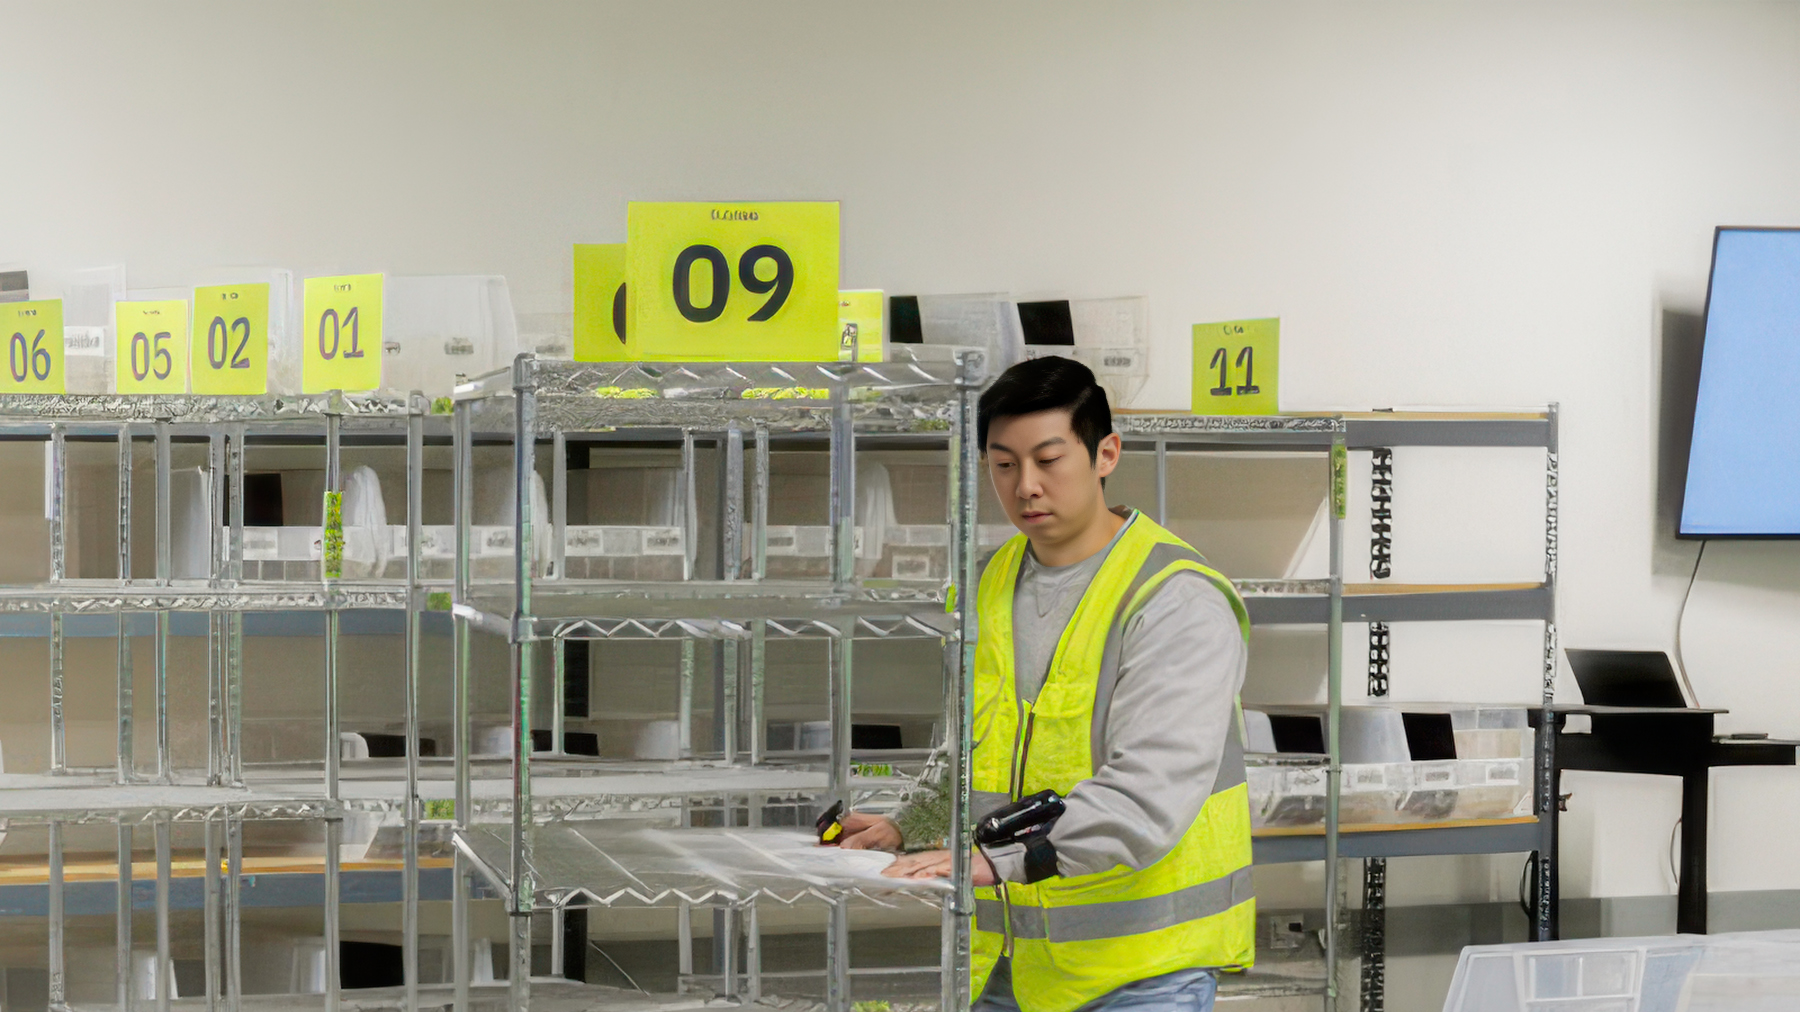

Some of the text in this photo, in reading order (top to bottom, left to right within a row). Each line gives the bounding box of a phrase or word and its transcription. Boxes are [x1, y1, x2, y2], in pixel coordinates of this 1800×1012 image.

[672, 244, 795, 323] 09
[10, 329, 51, 382] 06
[131, 331, 172, 381] 05
[208, 316, 251, 369] 02
[319, 306, 365, 360] 01
[1209, 346, 1260, 396] 11
